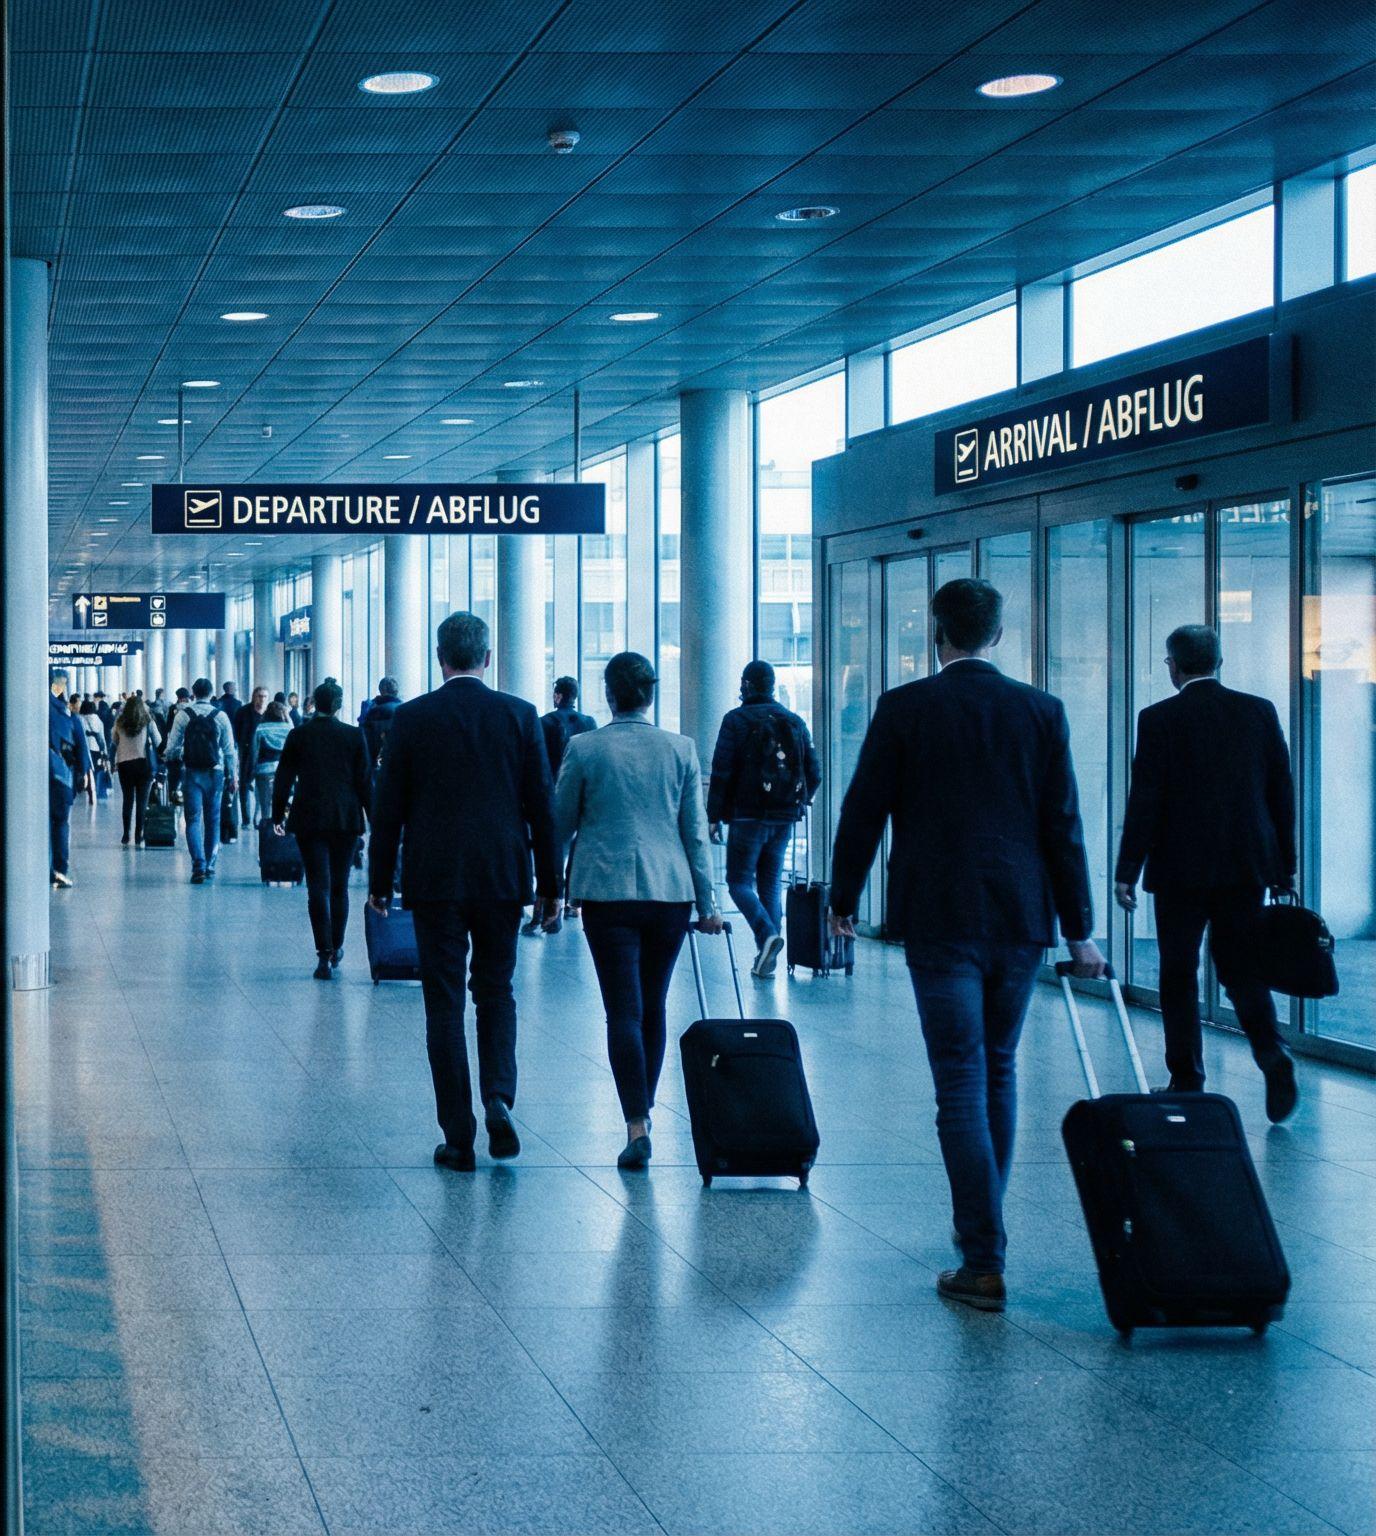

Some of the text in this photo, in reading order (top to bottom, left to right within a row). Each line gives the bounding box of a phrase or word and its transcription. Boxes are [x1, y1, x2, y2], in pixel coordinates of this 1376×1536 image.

[983, 409, 1078, 471] ARRIVAL
[1097, 374, 1204, 444] ABFLUG
[233, 494, 540, 525] DEPARTURE / ABFLUG
